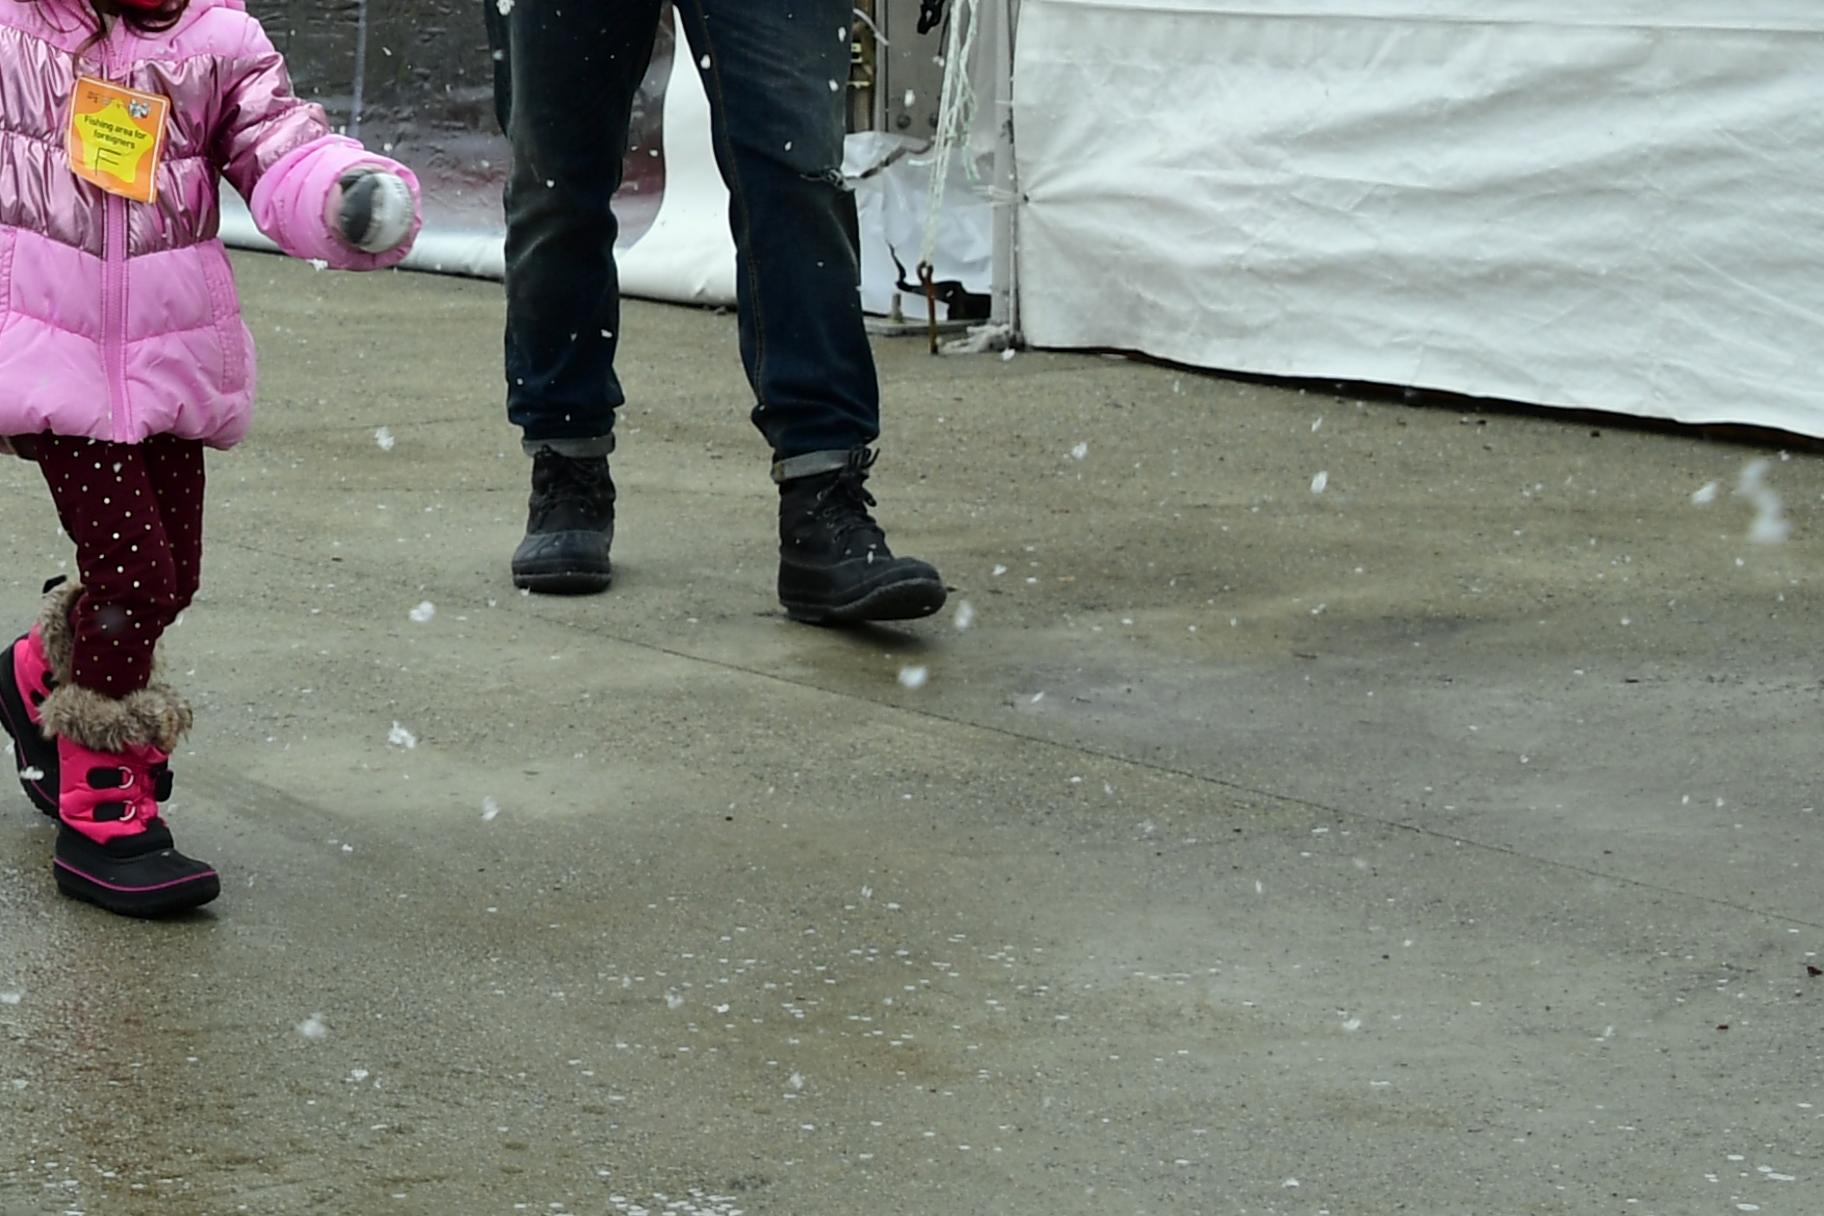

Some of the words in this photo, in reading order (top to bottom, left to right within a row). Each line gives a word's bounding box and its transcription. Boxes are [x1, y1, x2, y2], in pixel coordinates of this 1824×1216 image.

[84, 115, 113, 132] Fishing
[115, 126, 133, 137] area
[134, 130, 147, 139] for
[94, 129, 136, 149] foreigners
